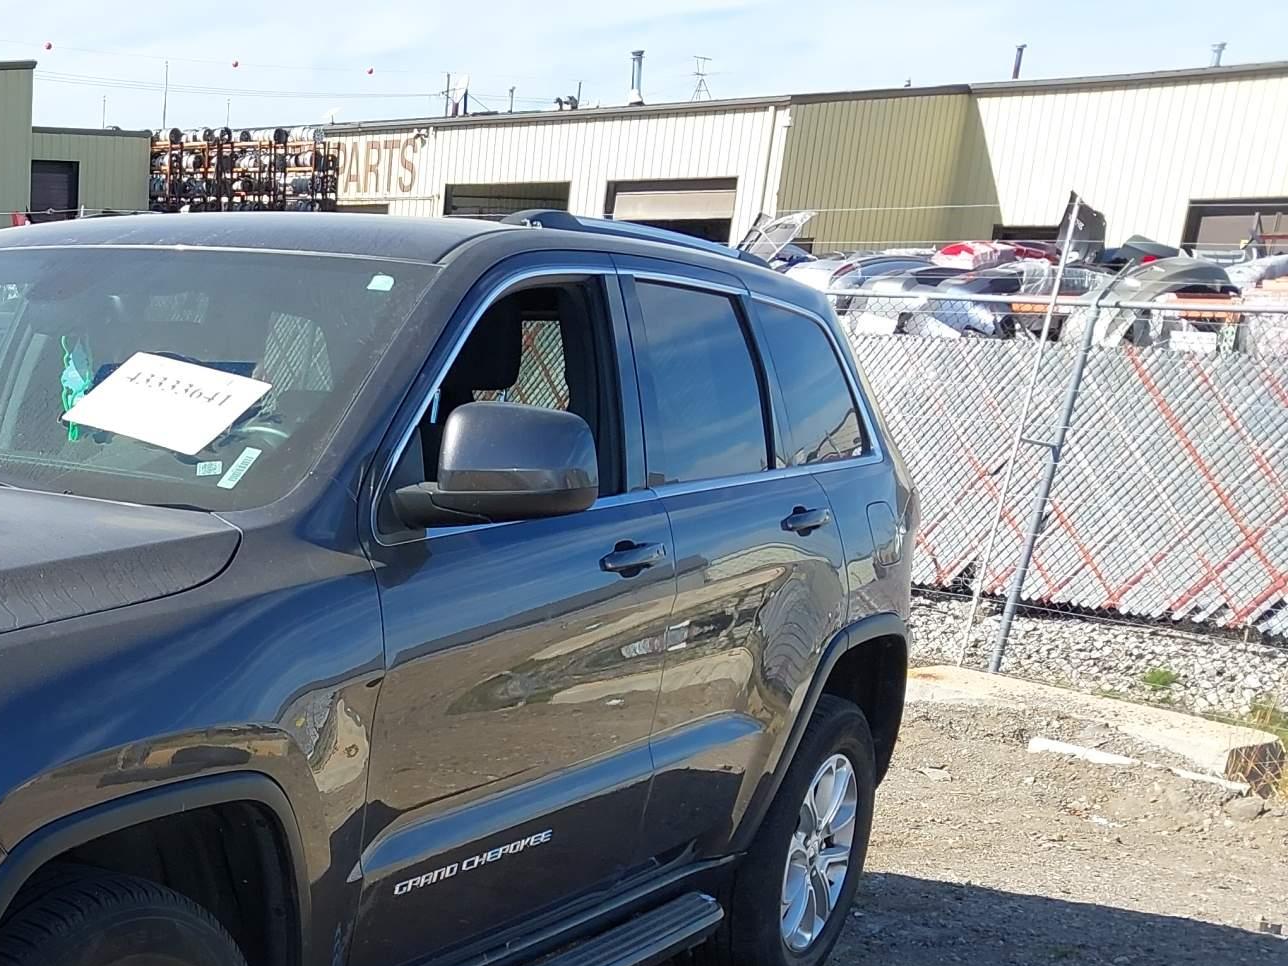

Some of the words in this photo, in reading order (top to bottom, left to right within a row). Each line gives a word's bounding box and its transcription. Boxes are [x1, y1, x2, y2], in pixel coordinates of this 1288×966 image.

[333, 138, 417, 193] PARTS
[126, 371, 233, 407] 43333641
[393, 862, 459, 896] GRAND
[461, 828, 554, 872] CHEROKEE
